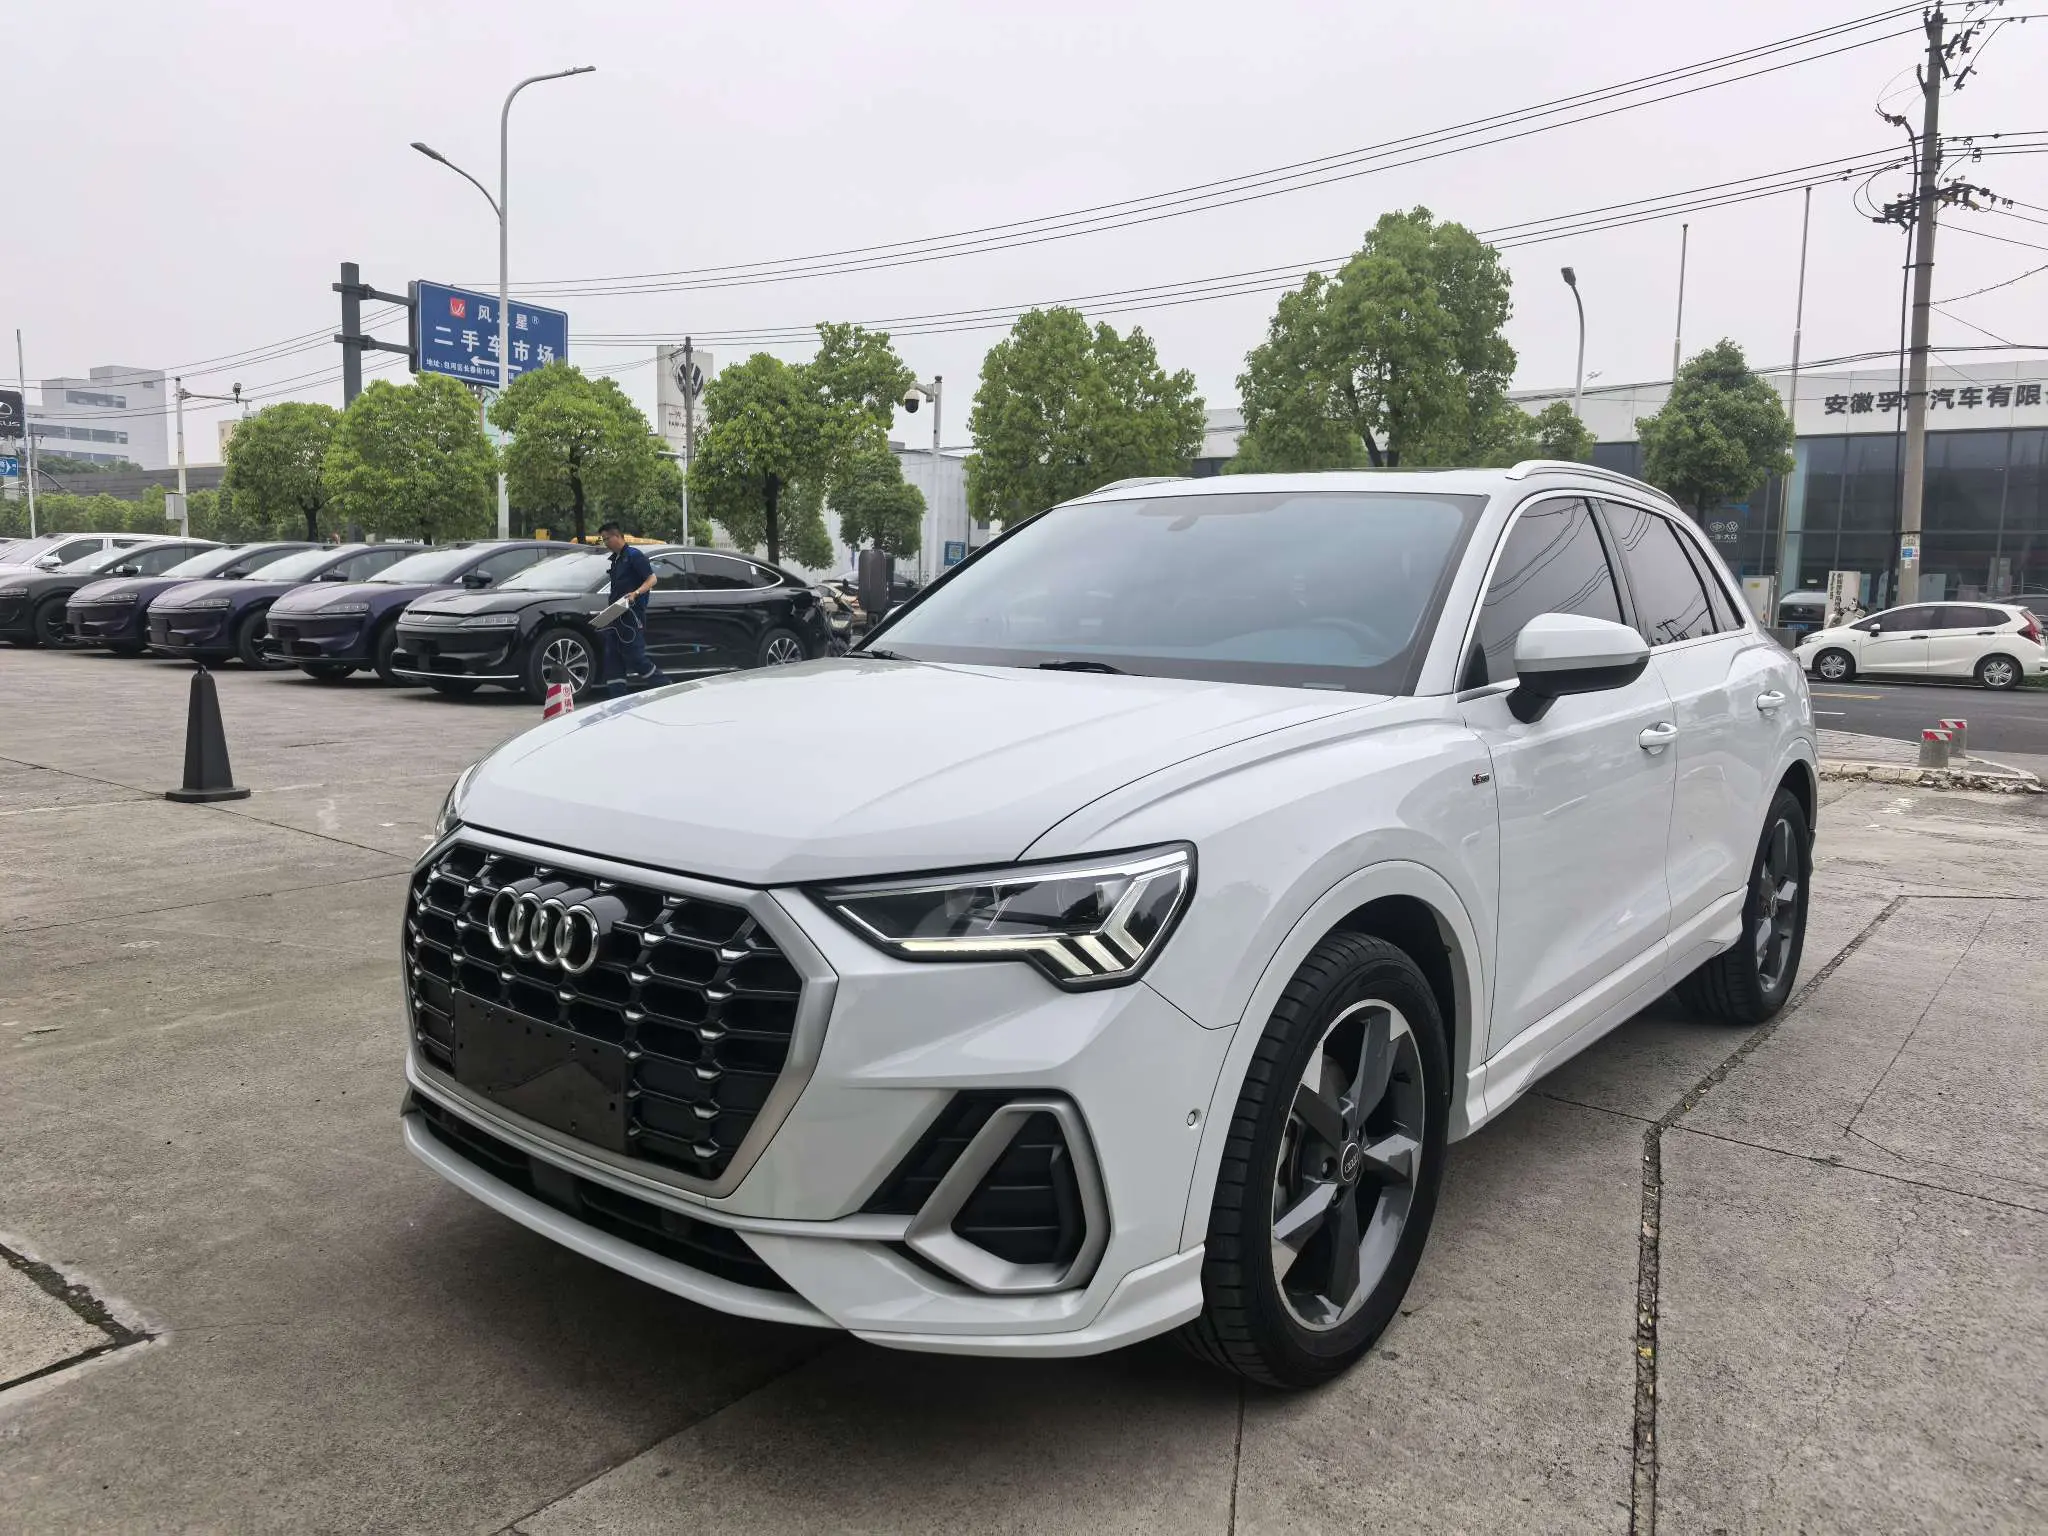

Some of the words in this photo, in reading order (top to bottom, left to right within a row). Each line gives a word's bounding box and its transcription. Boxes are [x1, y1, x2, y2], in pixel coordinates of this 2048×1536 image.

[478, 305, 528, 330] 风星
[434, 325, 554, 366] 二手车市场
[1825, 384, 2048, 415] 安徽孚汽车有限
